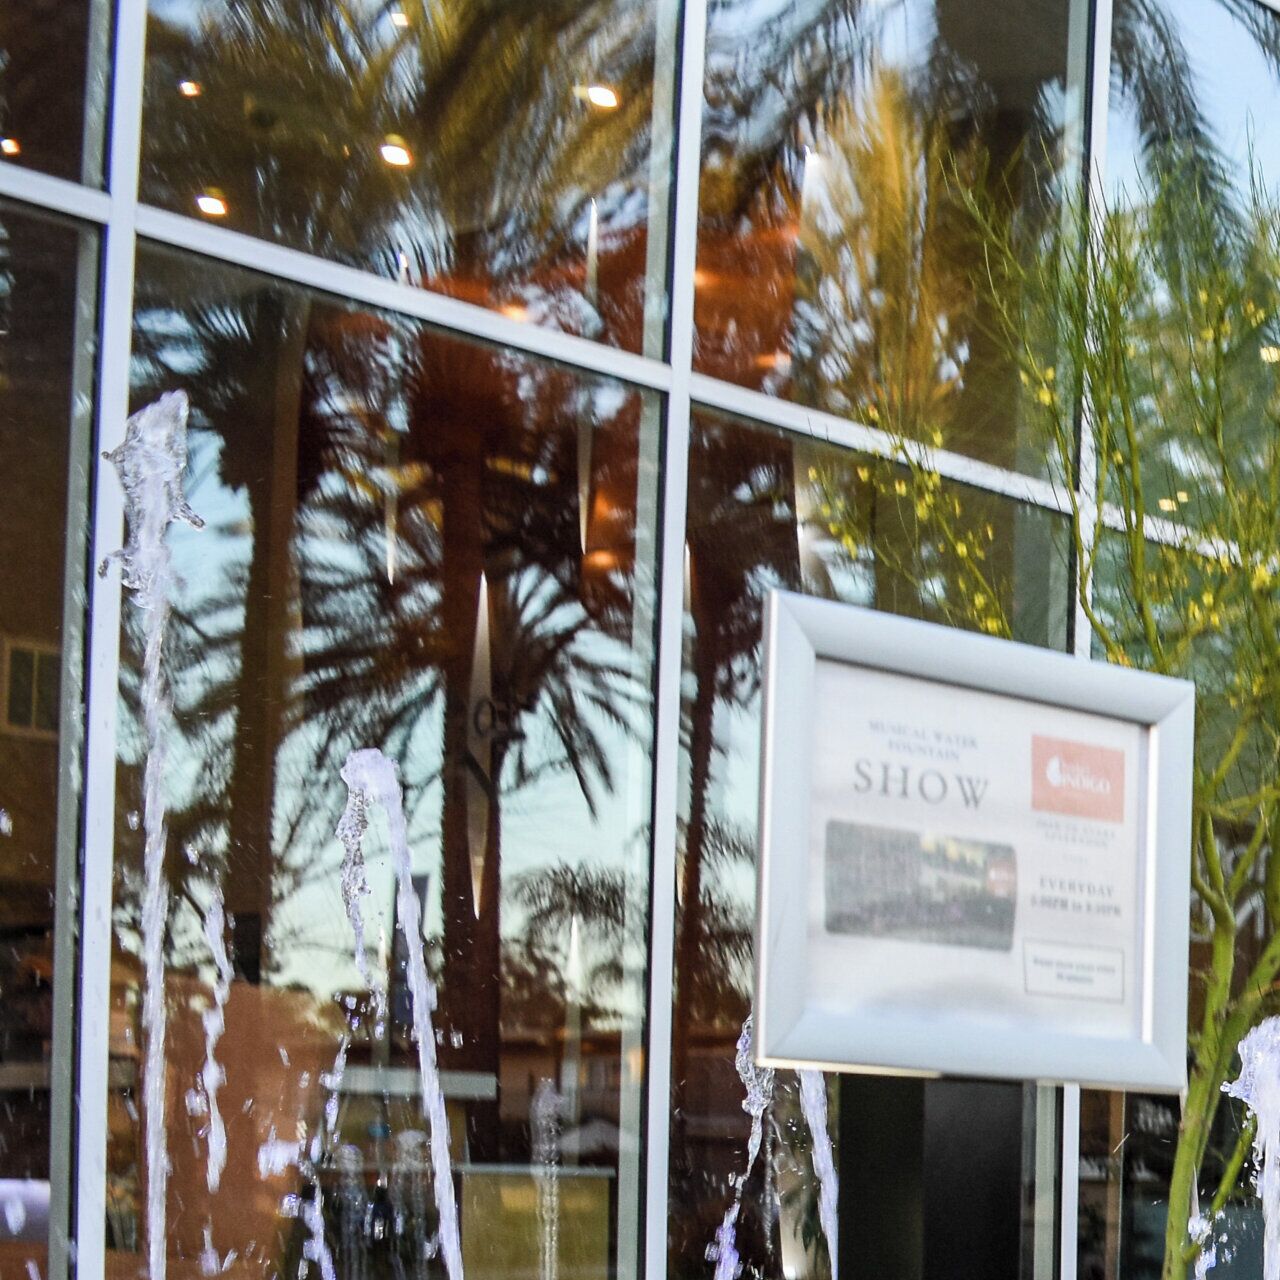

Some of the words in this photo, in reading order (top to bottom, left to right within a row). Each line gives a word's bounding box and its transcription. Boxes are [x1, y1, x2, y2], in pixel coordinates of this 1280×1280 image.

[888, 738, 960, 761] FOUNTAIN
[934, 729, 978, 750] WATER
[853, 757, 989, 810] SHOW
[1040, 876, 1113, 898] EVERYDAY
